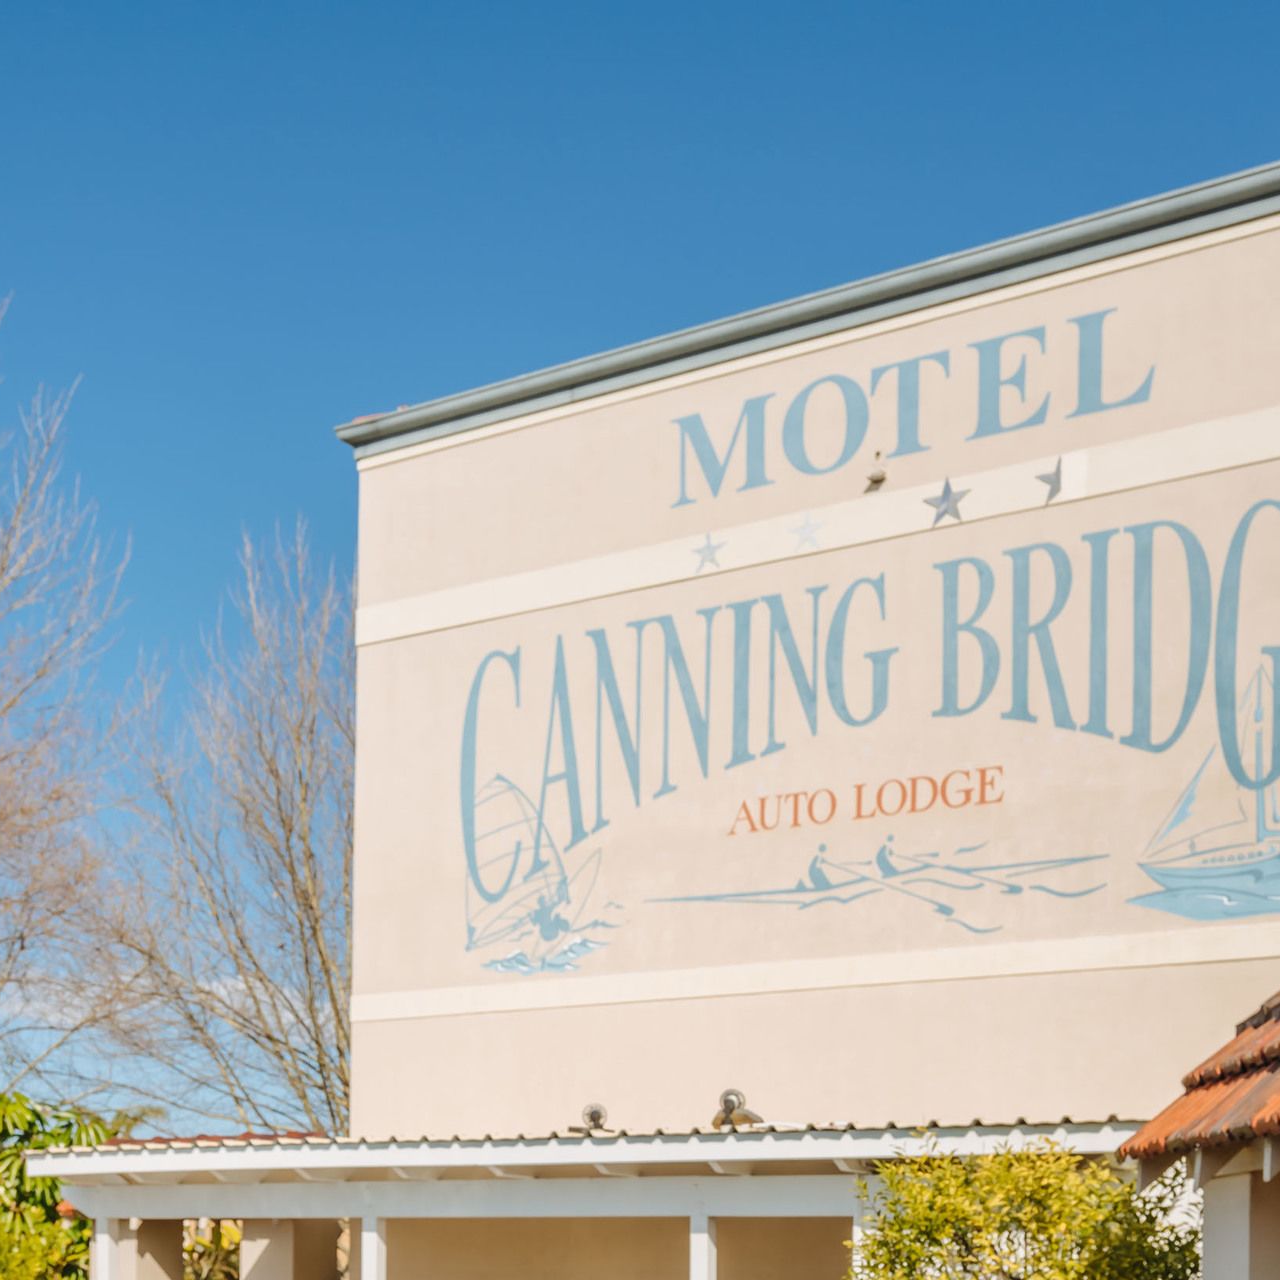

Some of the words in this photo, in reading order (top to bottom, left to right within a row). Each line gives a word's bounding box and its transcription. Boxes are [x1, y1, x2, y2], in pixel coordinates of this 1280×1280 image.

[671, 308, 1156, 506] MOTEL
[460, 573, 900, 904] CANNING
[728, 788, 838, 835] AUTO
[853, 765, 1006, 820] LODGE
